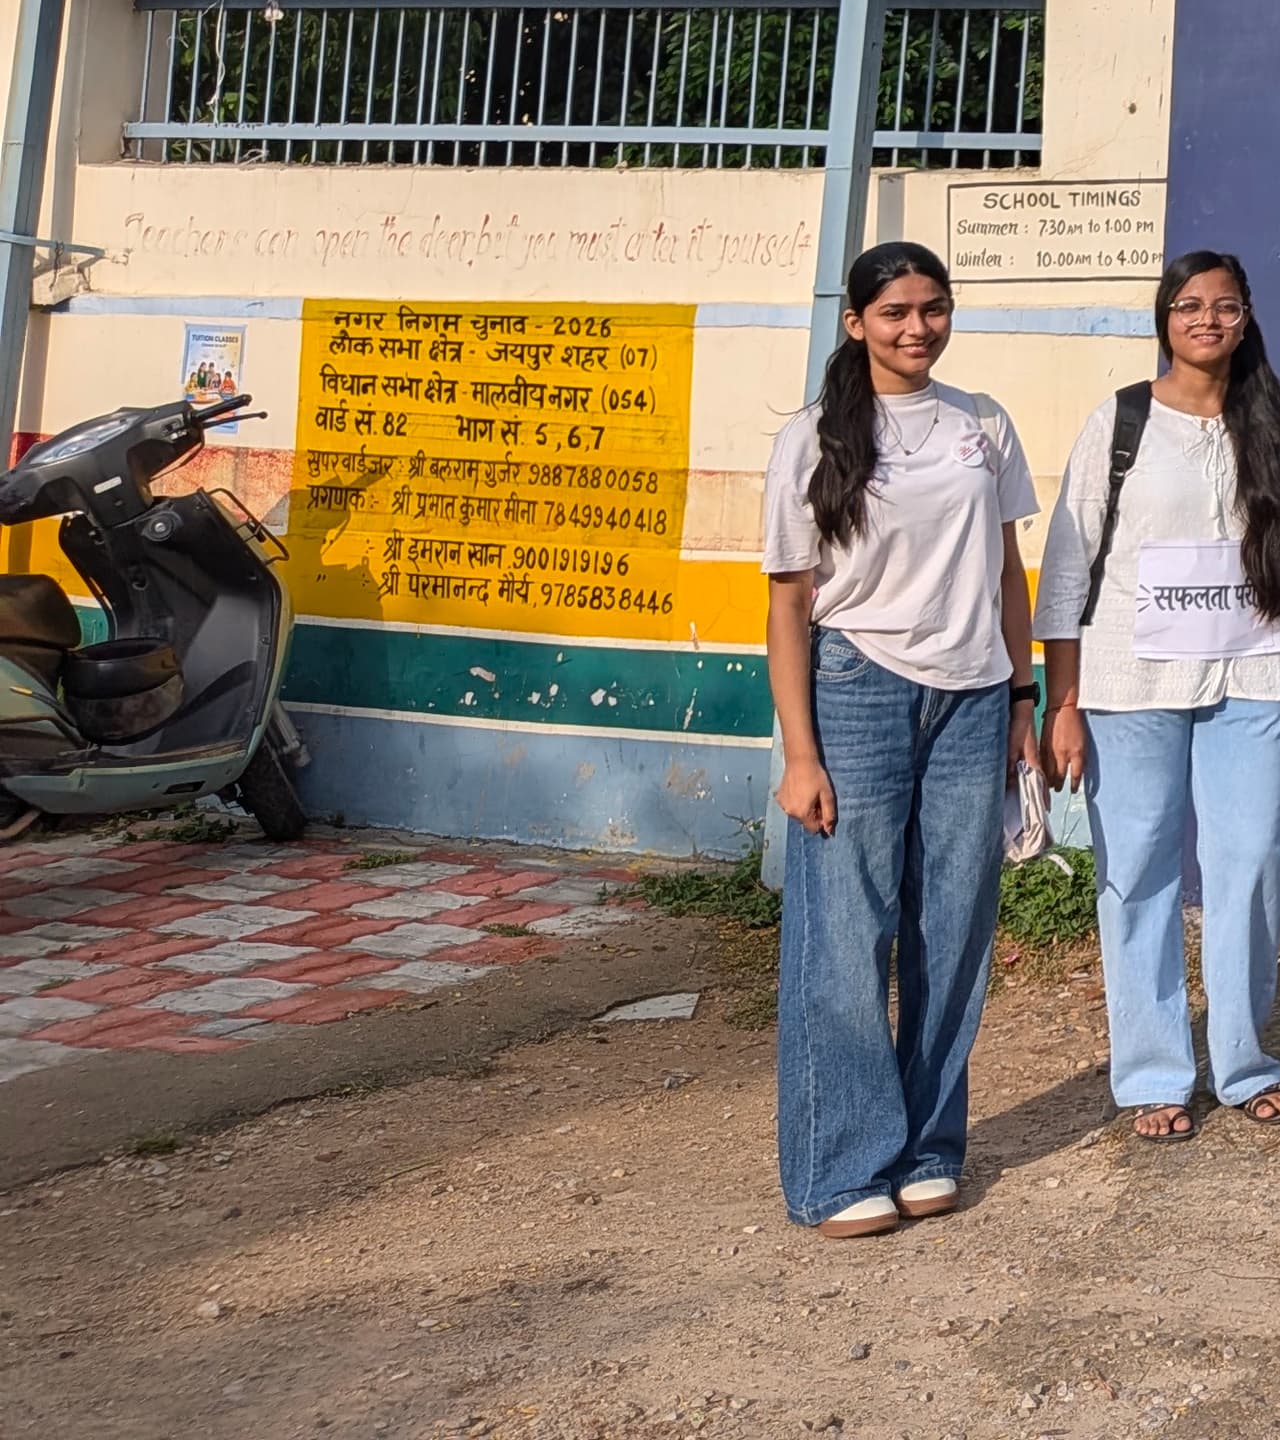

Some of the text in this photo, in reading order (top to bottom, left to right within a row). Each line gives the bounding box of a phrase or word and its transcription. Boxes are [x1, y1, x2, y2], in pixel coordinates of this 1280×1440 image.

[983, 190, 1142, 209] SCHOOL TIMINGS
[956, 219, 1019, 236] Summer
[1136, 221, 1154, 233] PM
[955, 248, 1112, 267] Winter to
[334, 305, 611, 340] नगर निगम चुनाव 2026
[379, 333, 658, 372] सभा क्षेत्र जयपुर शहर (07)
[319, 363, 377, 396] विधान
[381, 372, 423, 401] सभा
[424, 371, 459, 404] क्षेत्र
[601, 384, 656, 415] (054)
[315, 399, 494, 442] वार्ड 82 भाग
[408, 450, 659, 495] श्री 9887880058
[391, 485, 414, 516] श्री
[413, 491, 459, 521] प्रभात
[459, 494, 502, 526] कुमार
[504, 492, 538, 525] मीना
[544, 500, 667, 536] 7849940418
[382, 529, 404, 564] श्री
[377, 565, 401, 601] श्री
[541, 583, 673, 615] 9785838446
[1153, 584, 1232, 611] सफलता
